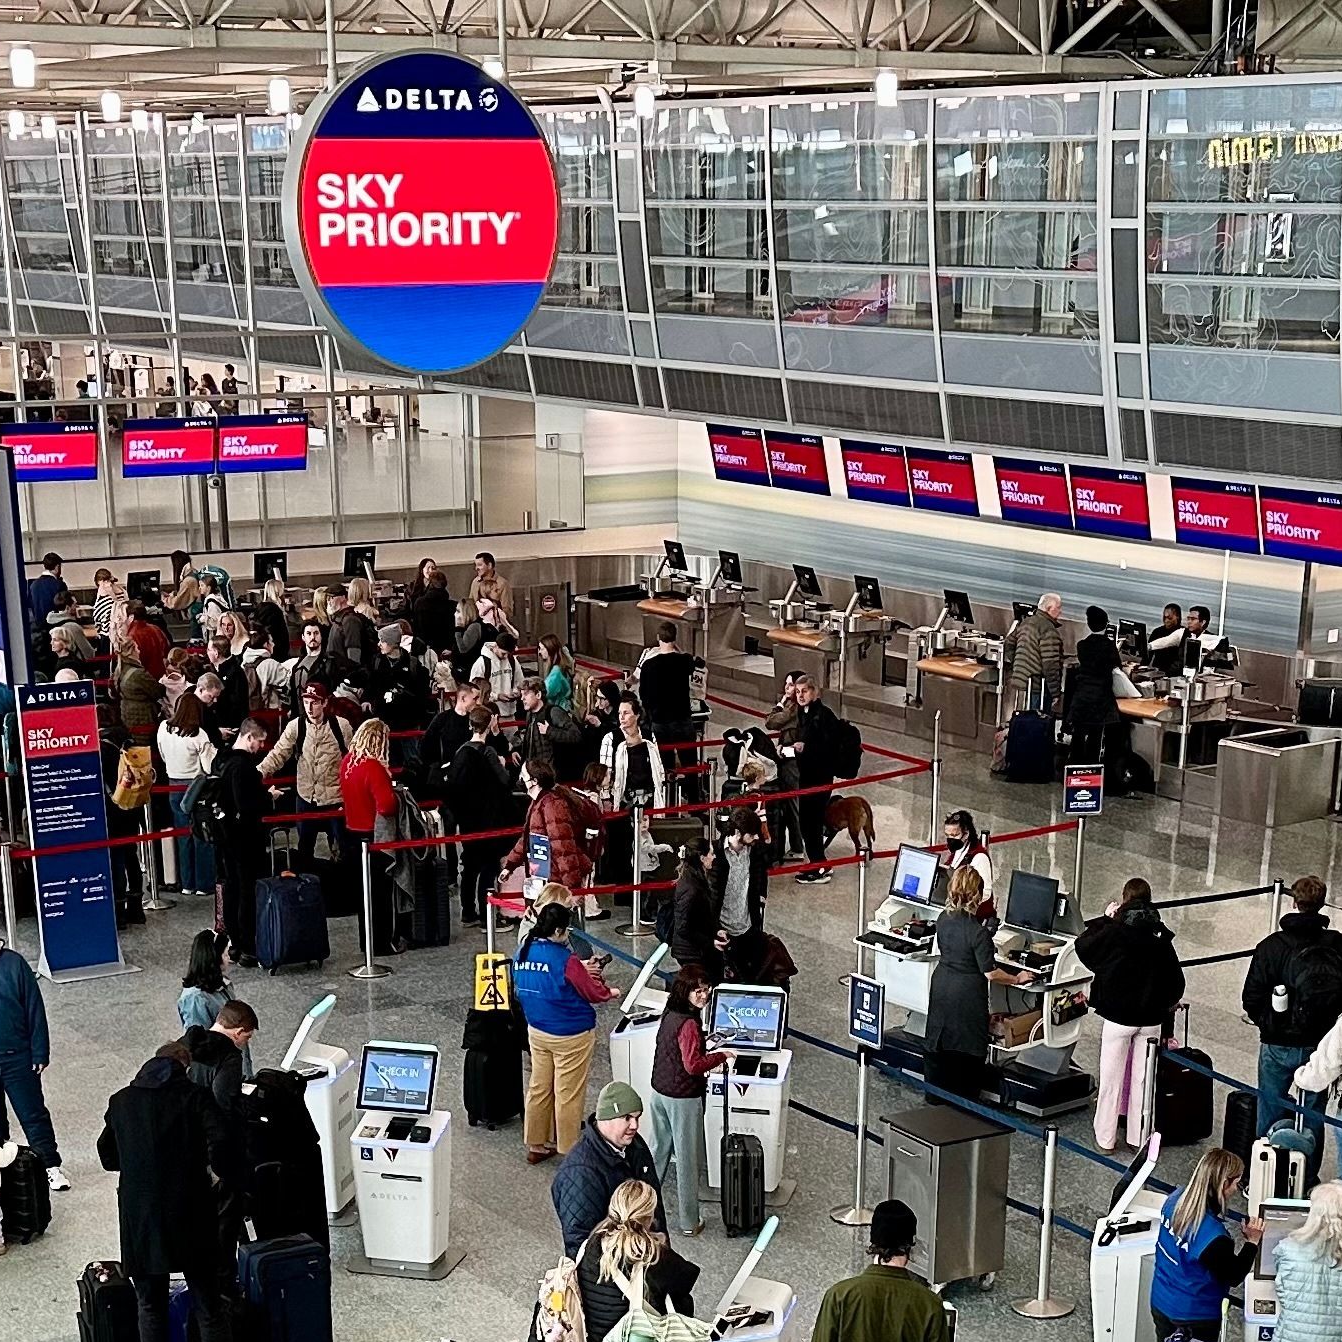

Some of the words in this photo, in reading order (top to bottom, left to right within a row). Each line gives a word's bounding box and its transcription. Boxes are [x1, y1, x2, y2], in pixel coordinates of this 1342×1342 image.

[386, 89, 473, 111] DELTA
[317, 174, 404, 209] SKY
[319, 211, 515, 247] PRIORITY
[129, 440, 154, 450] SKY
[223, 436, 248, 446] SKY
[129, 448, 186, 460] PRIORITY
[223, 444, 279, 456] PRIORITY
[912, 468, 929, 481] SKY
[913, 478, 954, 494] PRIORITY
[1001, 480, 1019, 494] SKY
[1002, 490, 1045, 506] PRIORITY
[1076, 488, 1095, 502] SKY
[1076, 500, 1122, 516] PRIORITY
[1178, 499, 1199, 514] SKY
[1178, 511, 1229, 528] PRIORITY
[1265, 510, 1289, 525] SKY
[1266, 523, 1320, 541] PRIORITY
[39, 690, 77, 702] DELTA
[28, 727, 53, 740] SKY
[28, 735, 89, 751] PRIORITY
[728, 1006, 756, 1017] CHECK
[758, 1008, 768, 1018] IN
[378, 1065, 407, 1077] CHECK
[409, 1068, 419, 1078] IN
